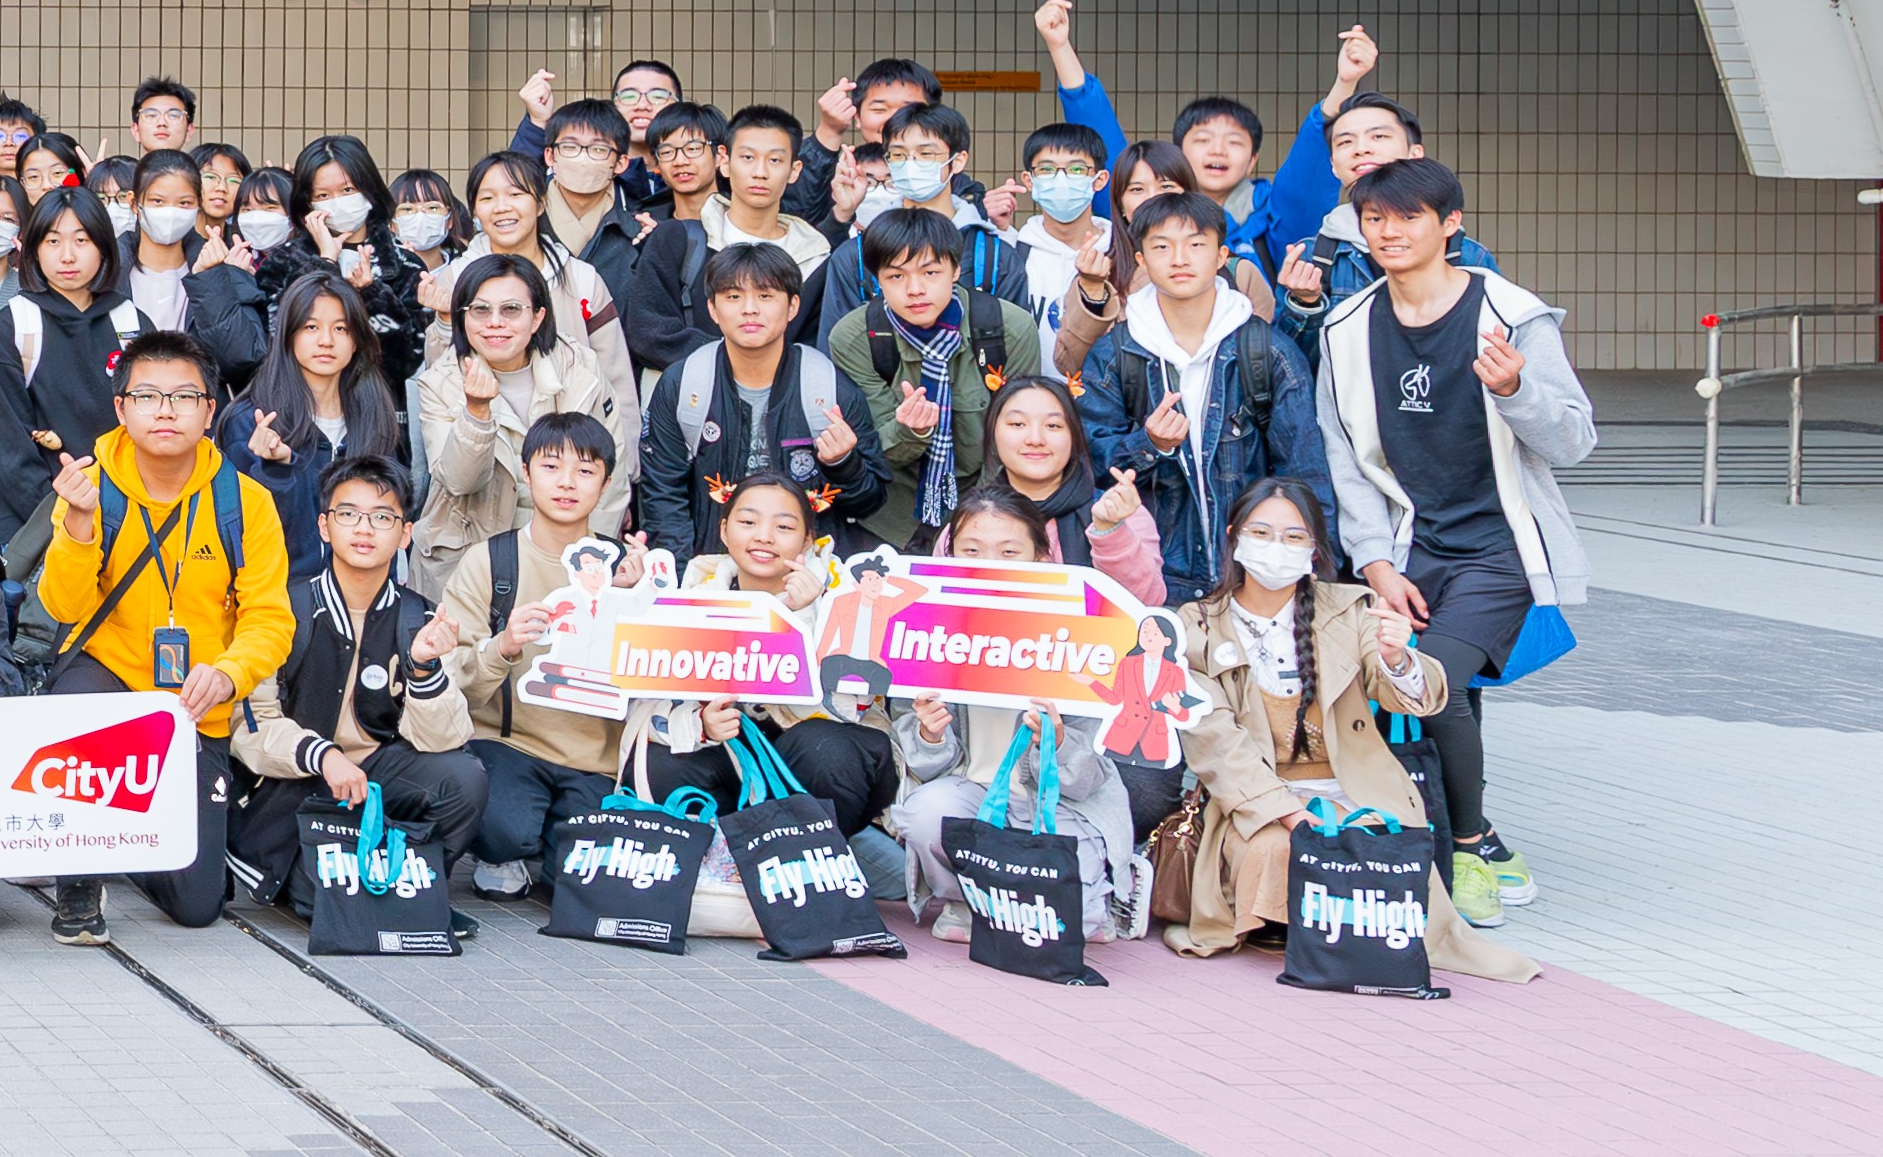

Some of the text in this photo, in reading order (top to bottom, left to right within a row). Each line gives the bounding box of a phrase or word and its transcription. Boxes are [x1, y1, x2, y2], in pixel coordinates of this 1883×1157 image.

[191, 552, 217, 561] adidas
[615, 639, 800, 684] Innovative
[889, 620, 1116, 676] Interactive
[30, 754, 159, 806] CityU
[55, 833, 73, 847] of
[75, 833, 117, 849] Hong
[119, 832, 159, 847] Kong
[311, 821, 324, 831] AT
[568, 814, 690, 839] AT CITYU, YOU CAN
[317, 843, 359, 896] Fly
[563, 837, 676, 889] Fly High
[1299, 853, 1319, 865] AT
[1366, 861, 1390, 873] YOU
[1393, 861, 1422, 874] CAN
[1303, 881, 1425, 949] Fly High
